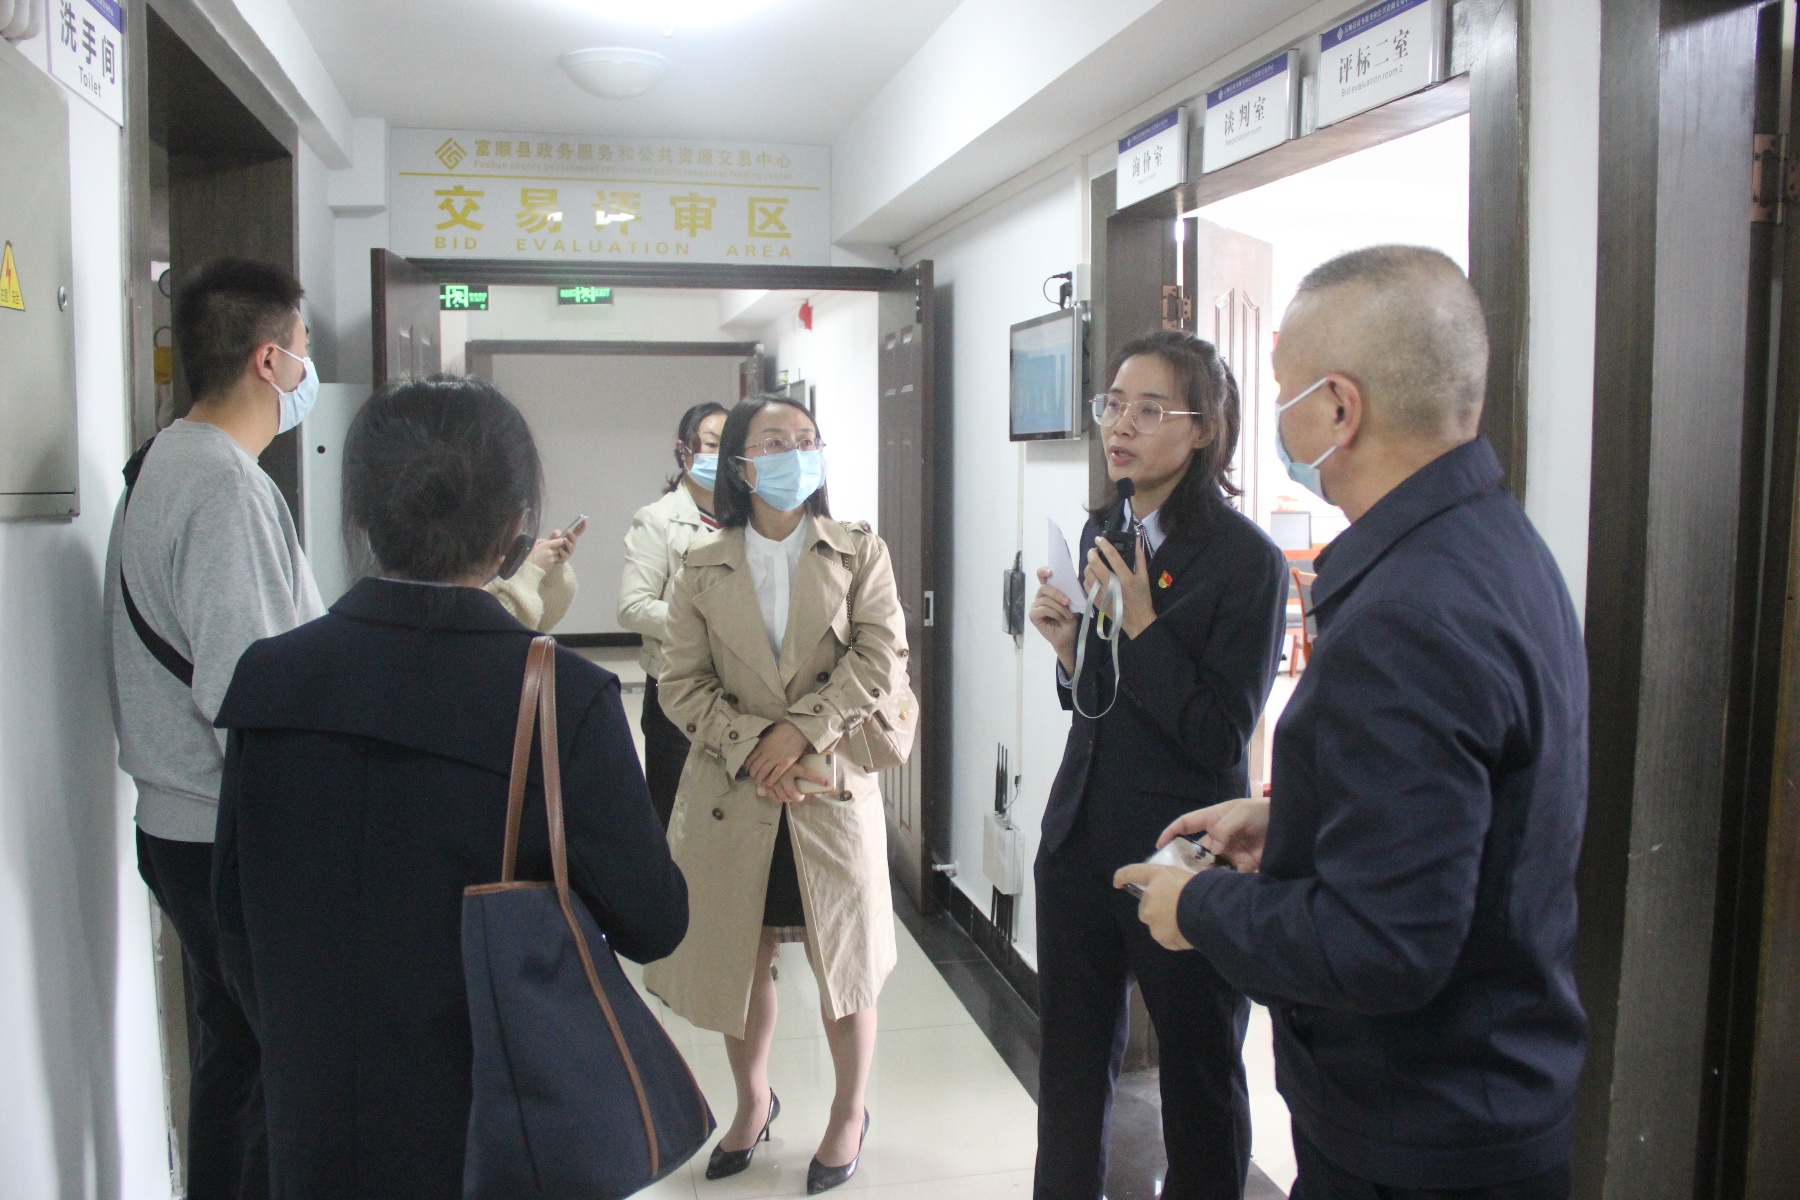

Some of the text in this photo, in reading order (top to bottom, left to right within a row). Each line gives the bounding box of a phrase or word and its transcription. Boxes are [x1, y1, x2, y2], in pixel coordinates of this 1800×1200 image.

[60, 0, 115, 85] 洗手间
[1339, 28, 1410, 85] 评标二室
[78, 65, 102, 98] Toilet
[1382, 66, 1398, 80] room
[1399, 63, 1404, 73] 2
[1224, 95, 1266, 136] 谈判室
[474, 139, 792, 169] 富顺县政务服务和公共资源交易中心
[1132, 145, 1163, 178] 询价室
[434, 185, 792, 239] 交易评审区
[434, 236, 792, 258] BID EVALUATION AREA
